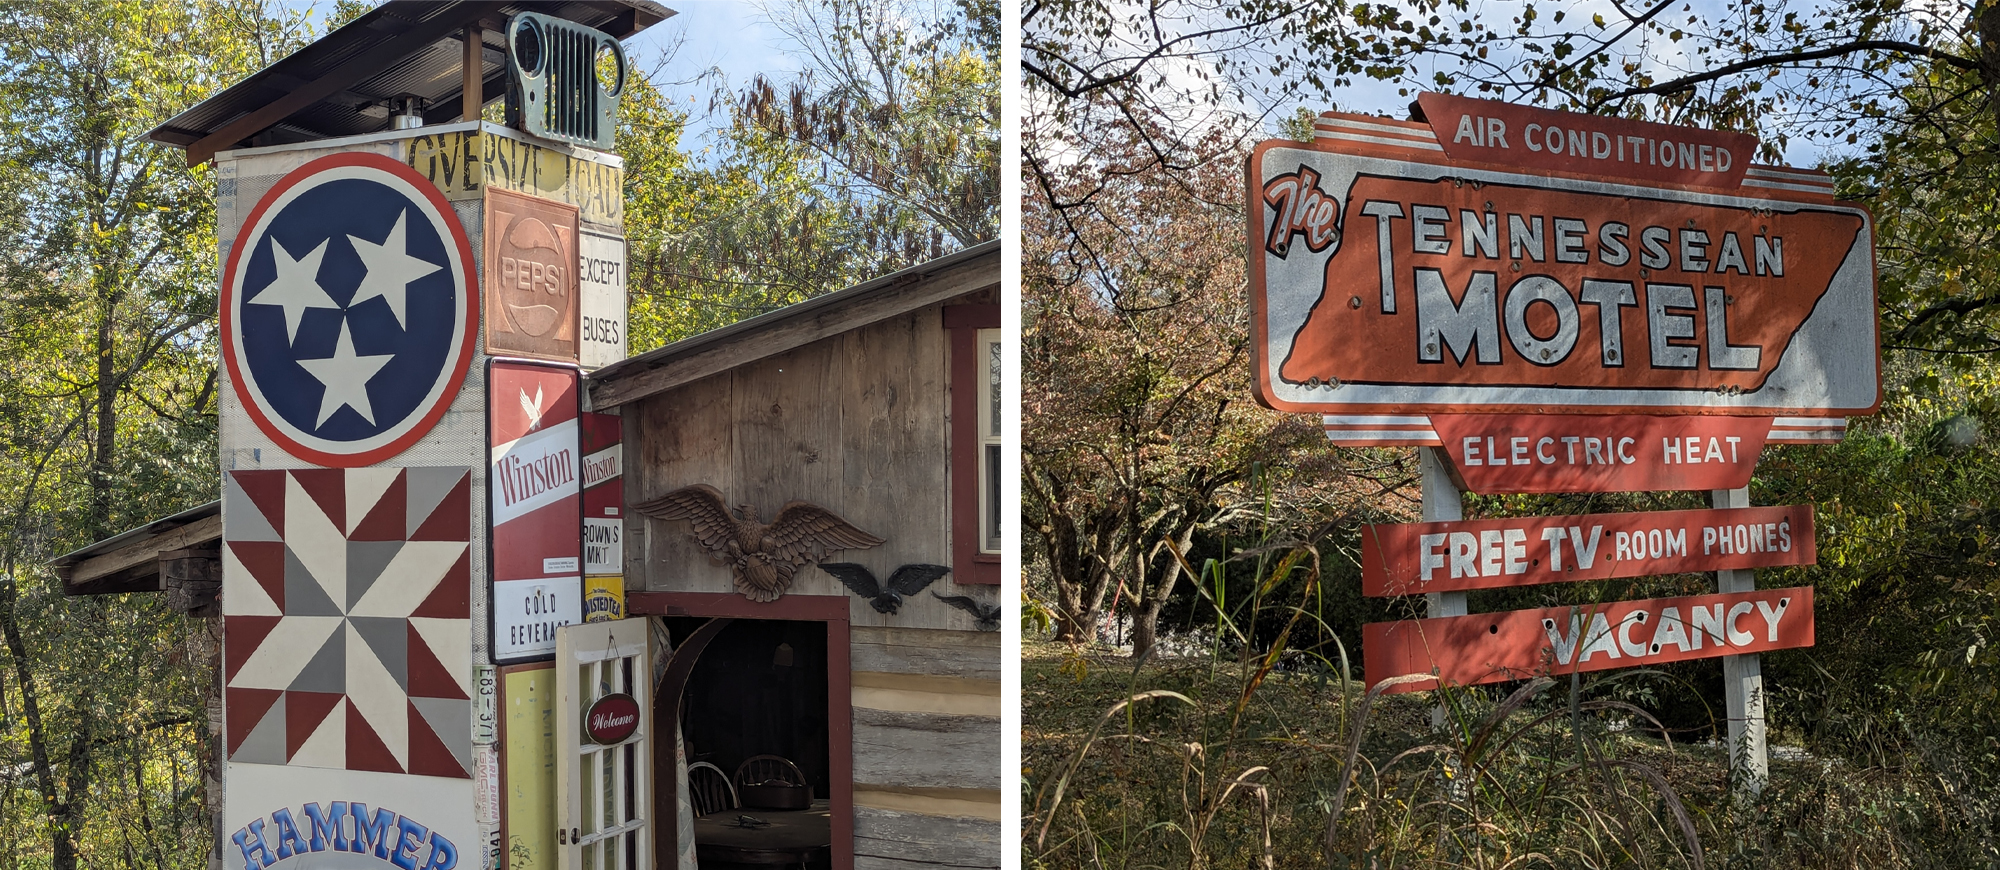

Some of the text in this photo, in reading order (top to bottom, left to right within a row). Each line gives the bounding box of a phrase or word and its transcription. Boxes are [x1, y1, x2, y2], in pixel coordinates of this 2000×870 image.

[408, 130, 542, 196] OVERSIZE
[1453, 114, 1733, 173] AIR CONDITIONED
[1265, 168, 1339, 254] The
[501, 256, 565, 298] PEPSI
[580, 256, 621, 287] EXCEPT
[1360, 199, 1785, 314] TENNESSEAN
[583, 316, 619, 345] BUSES
[1414, 267, 1764, 373] MOTEL
[1463, 435, 1741, 467] ELECTRIC HEAT
[497, 447, 575, 507] Winston
[587, 545, 609, 564] MKT
[1419, 520, 1792, 582] FREE TV ROOM PHONES
[525, 593, 556, 616] COLD
[609, 596, 621, 618] TEA
[1541, 597, 1791, 666] VACANCY
[593, 712, 635, 731] Welcome
[479, 752, 488, 789] GMC
[490, 785, 499, 820] DUNN
[231, 801, 459, 870] HAMMER
